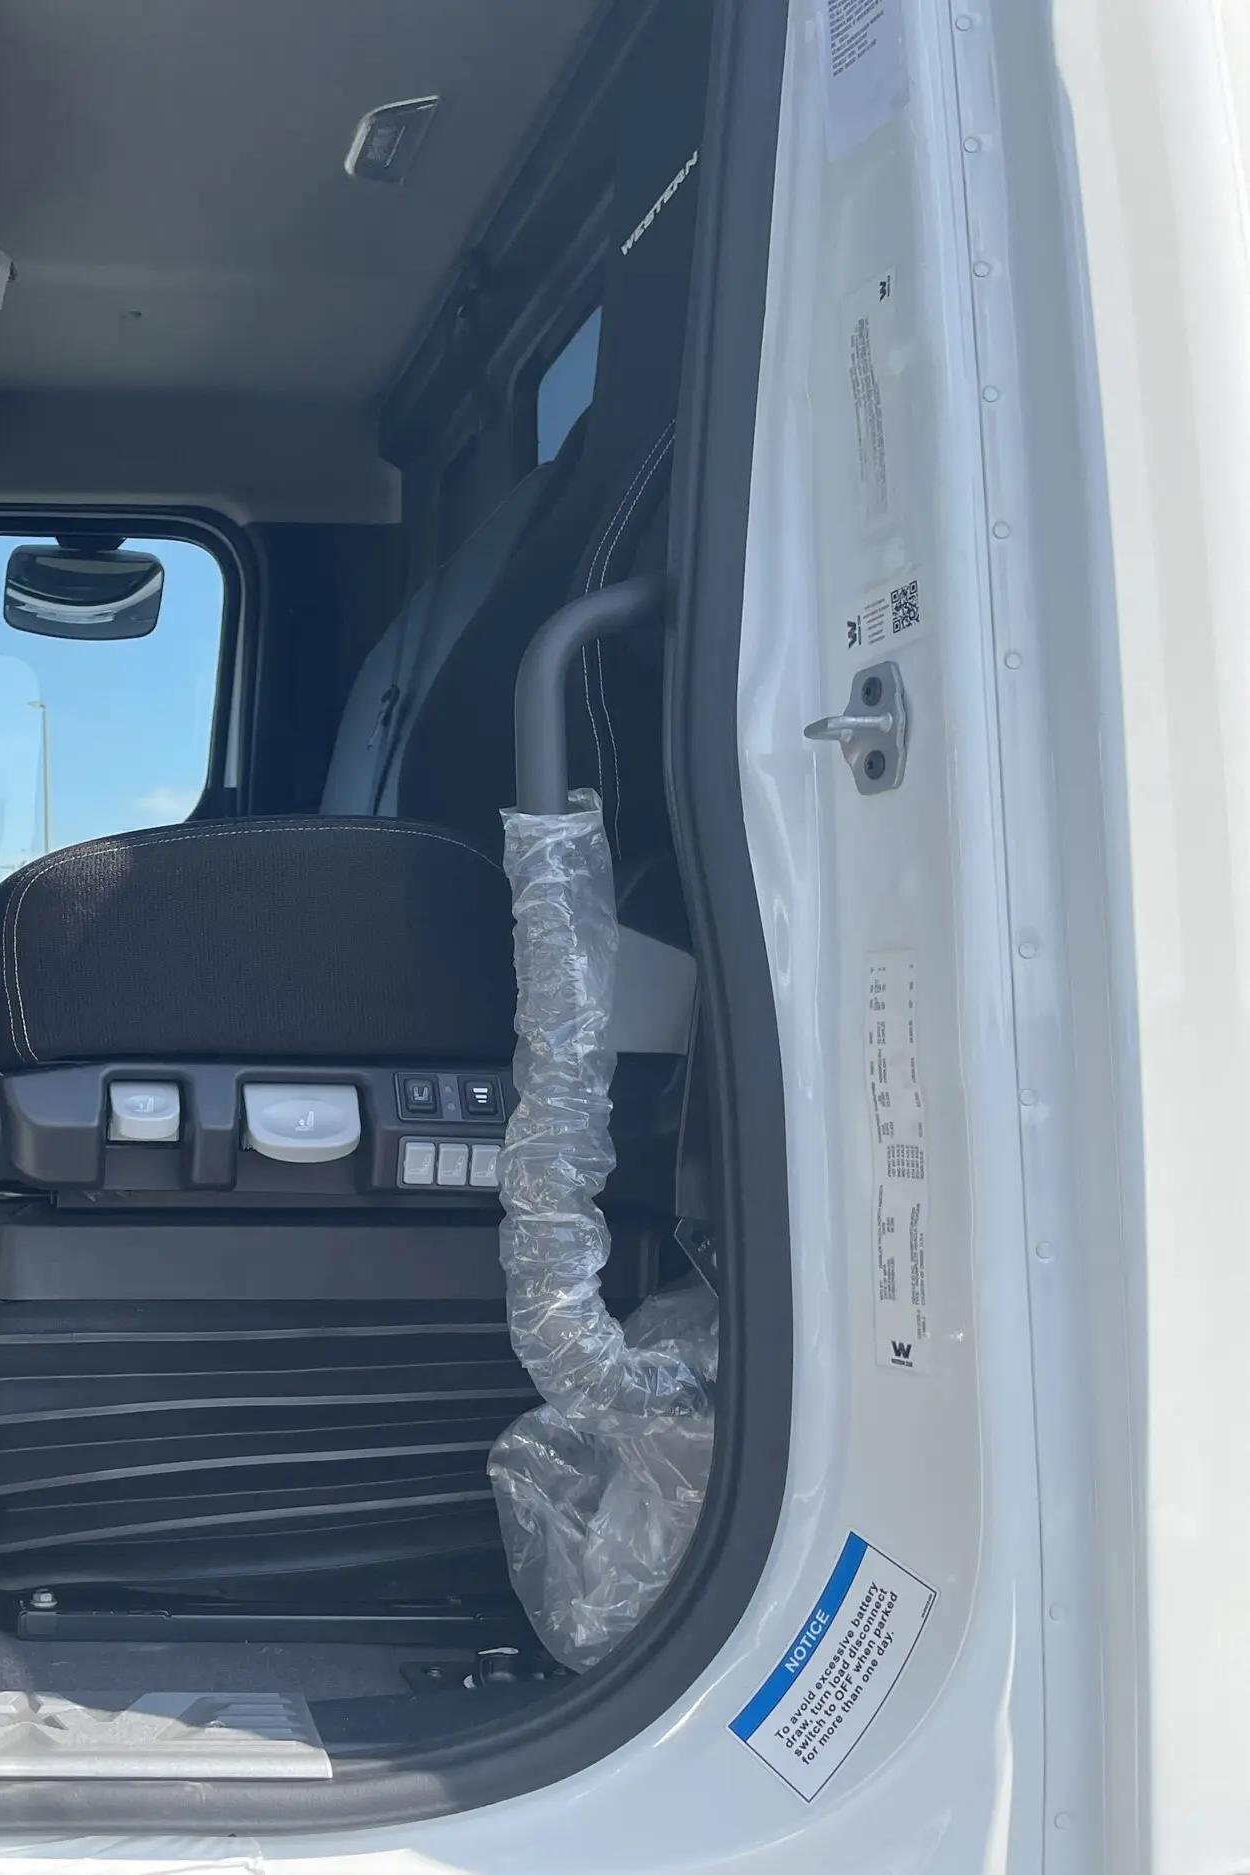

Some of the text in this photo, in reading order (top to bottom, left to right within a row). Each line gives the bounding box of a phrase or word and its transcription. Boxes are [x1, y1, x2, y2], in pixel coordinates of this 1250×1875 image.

[621, 149, 698, 256] WESTERN
[774, 1581, 879, 1741] To avoid excessive battery
[784, 1608, 830, 1674] NOTICE
[785, 1587, 888, 1749] draw, turn load disconnect
[793, 1592, 899, 1757] switch to OFF when parked
[801, 1630, 895, 1766] for more than one day.
